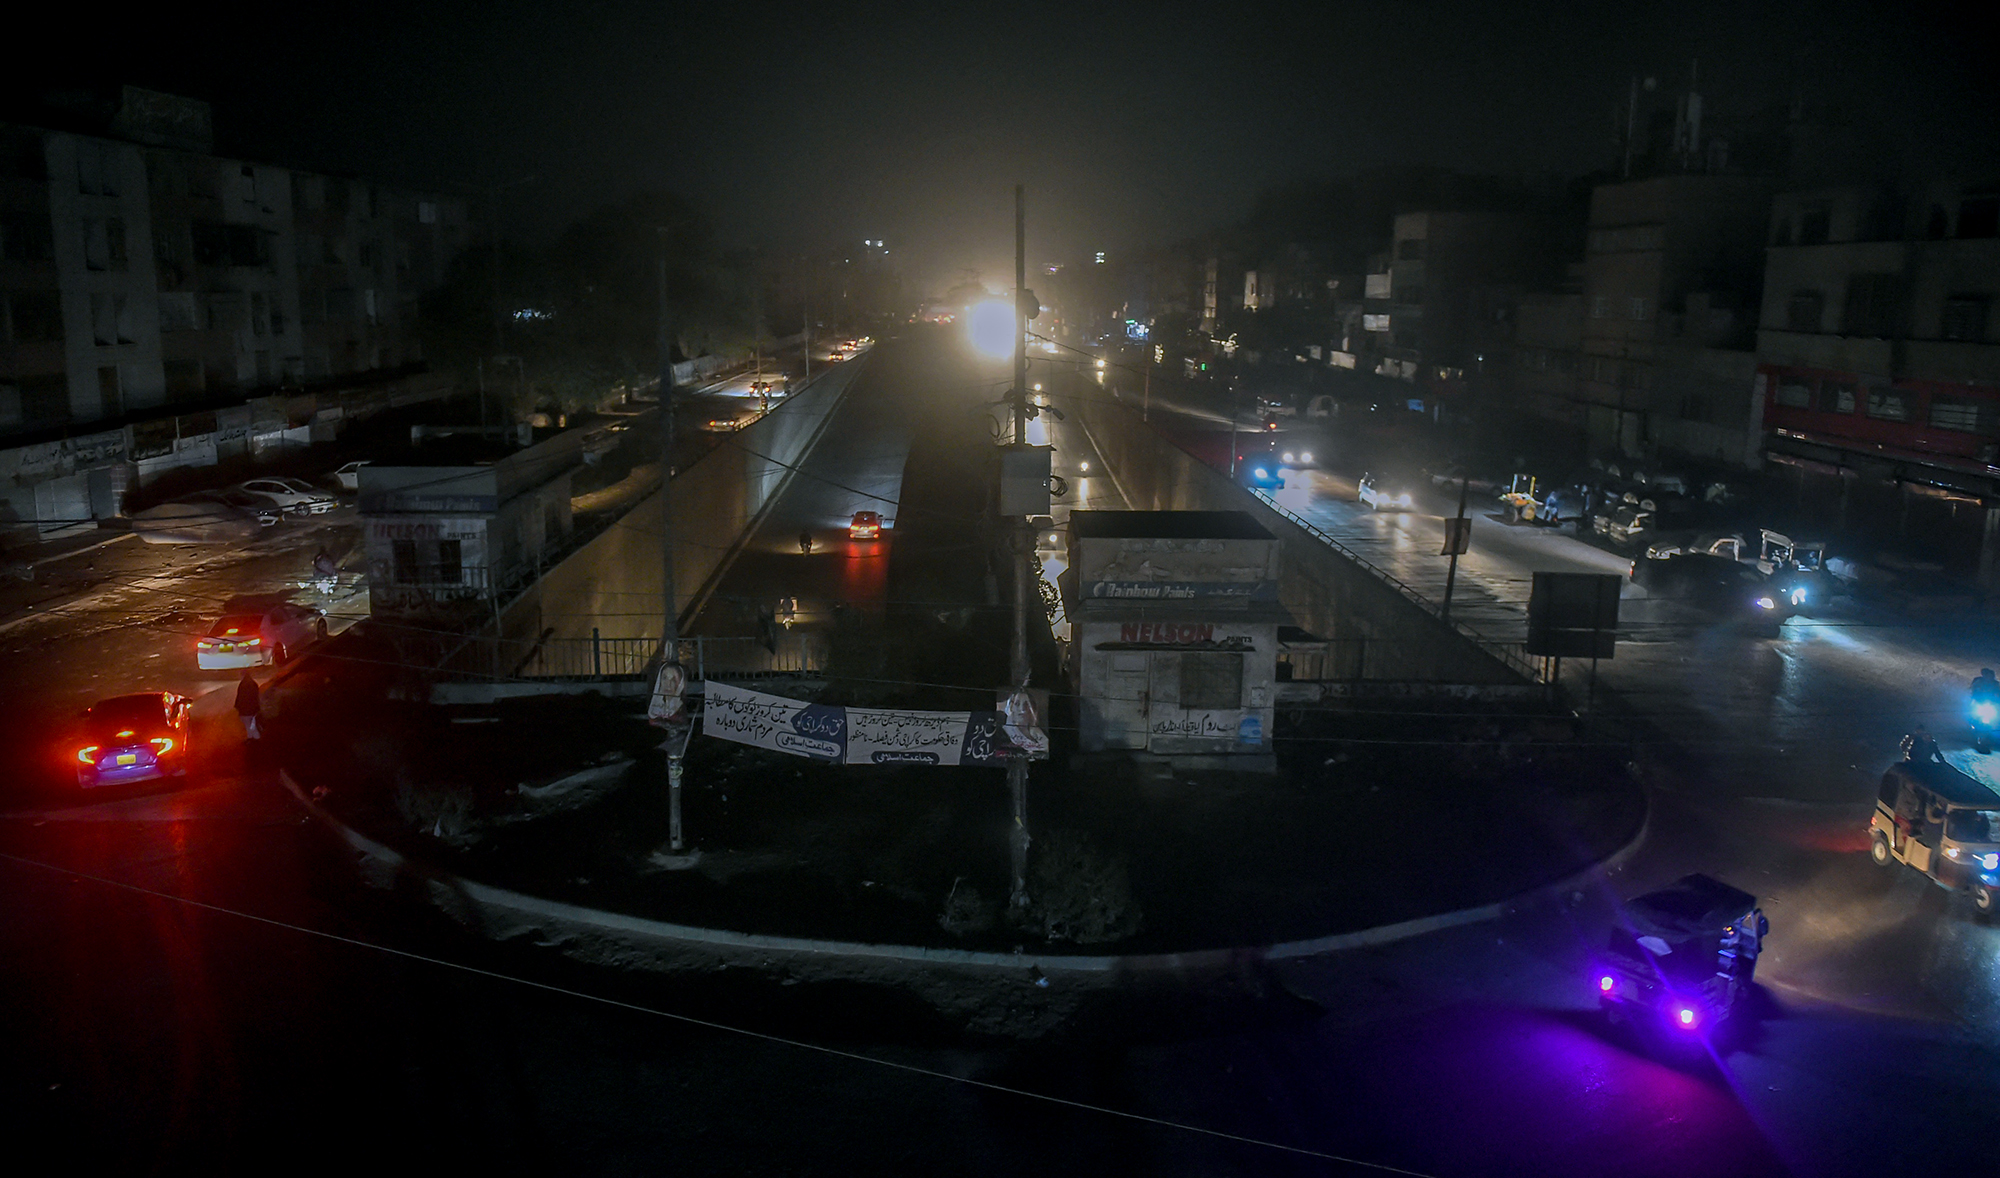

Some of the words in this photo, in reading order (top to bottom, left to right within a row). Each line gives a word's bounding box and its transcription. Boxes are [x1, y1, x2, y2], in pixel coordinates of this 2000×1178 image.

[447, 532, 477, 540] PAINTS
[1106, 583, 1160, 598] Rainbow
[1163, 585, 1195, 599] Paints
[1120, 623, 1214, 642] NELSON
[1226, 636, 1253, 644] PAINTS
[705, 692, 730, 710] مطالبہ
[728, 697, 738, 710] کا
[756, 702, 777, 718] کروڑ
[771, 704, 788, 724] تین
[716, 713, 736, 730] دوبارہ
[735, 715, 757, 732] شماری
[795, 711, 808, 728] کو
[802, 715, 828, 734] کراچی
[828, 717, 844, 736] حق
[755, 723, 773, 740] مردم
[872, 731, 889, 745] فیصلہ
[888, 727, 900, 746] دشمن
[899, 731, 918, 748] کراچی
[921, 730, 944, 744] حکومت
[943, 731, 958, 746] وفاقی
[781, 735, 806, 748] اسلامی
[806, 741, 835, 755] جماعت
[965, 734, 980, 756] کو
[972, 739, 997, 761] راچی
[876, 753, 902, 763] اسلامی
[903, 753, 934, 764] جماعت
